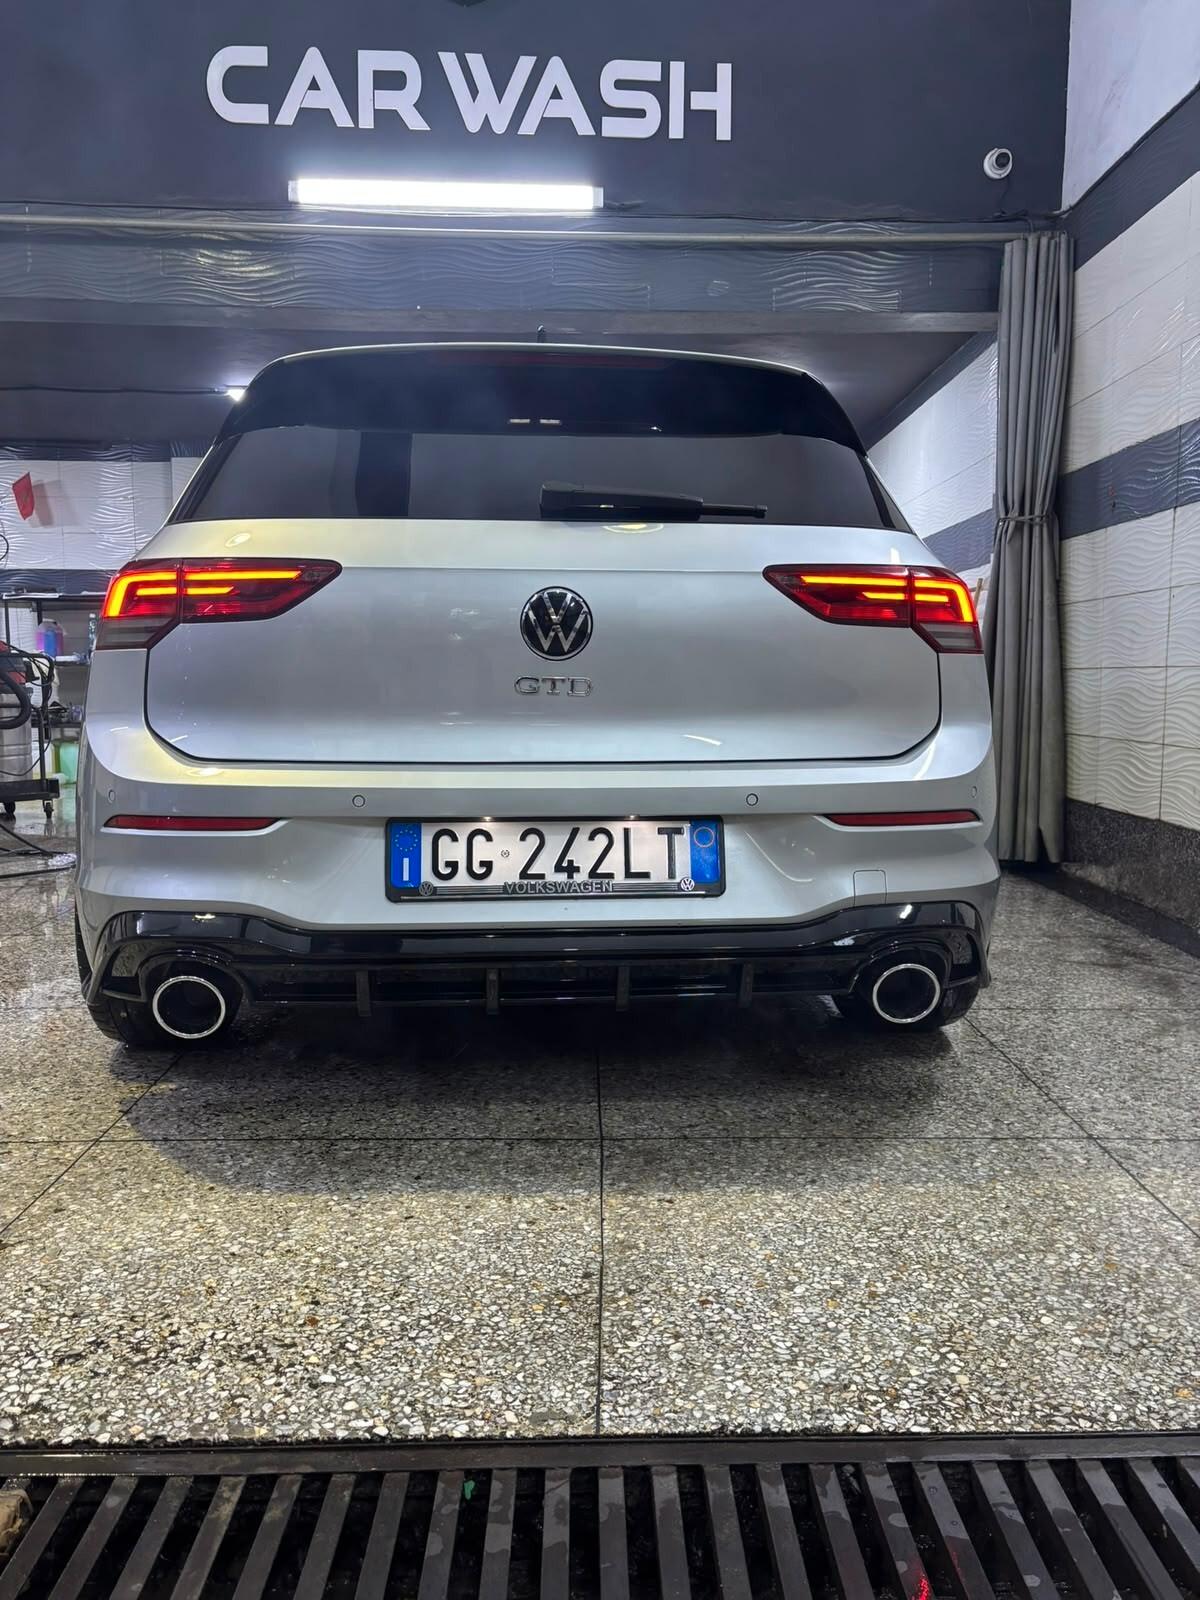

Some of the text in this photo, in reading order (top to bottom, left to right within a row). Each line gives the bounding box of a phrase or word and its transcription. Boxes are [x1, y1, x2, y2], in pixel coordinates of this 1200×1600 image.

[205, 45, 733, 141] CAR WASH
[514, 676, 592, 697] GTD
[431, 827, 494, 881] GG
[504, 880, 613, 895] VOLKSWAGEN
